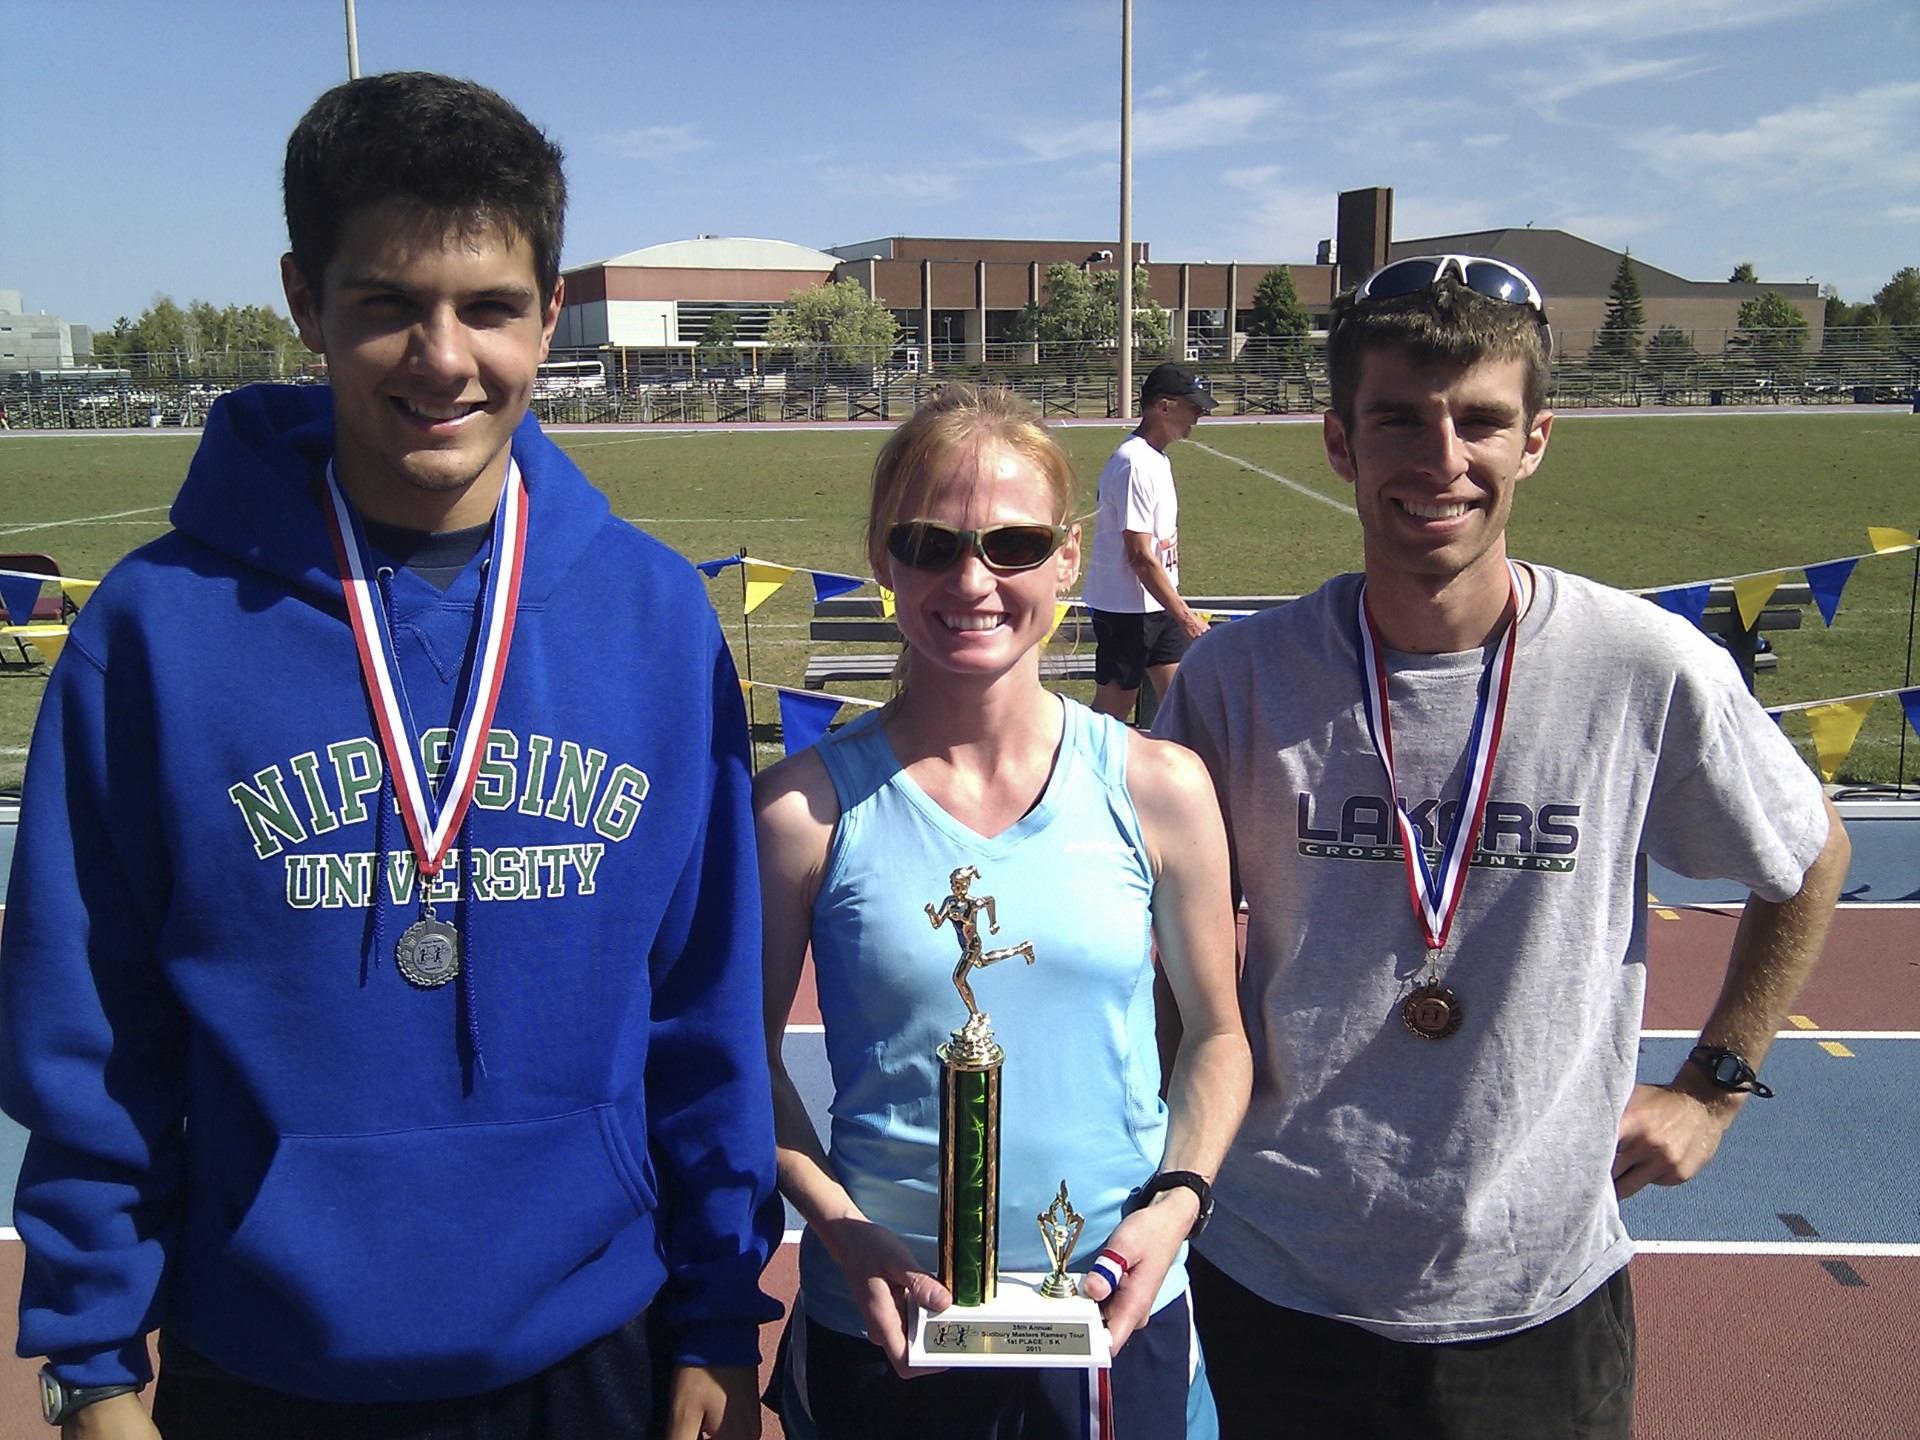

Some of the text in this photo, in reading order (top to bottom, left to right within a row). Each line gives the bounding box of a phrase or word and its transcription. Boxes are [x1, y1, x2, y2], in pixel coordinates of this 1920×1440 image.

[228, 727, 650, 859] NIPSSING
[1305, 844, 1575, 868] CROSS CUNTRY
